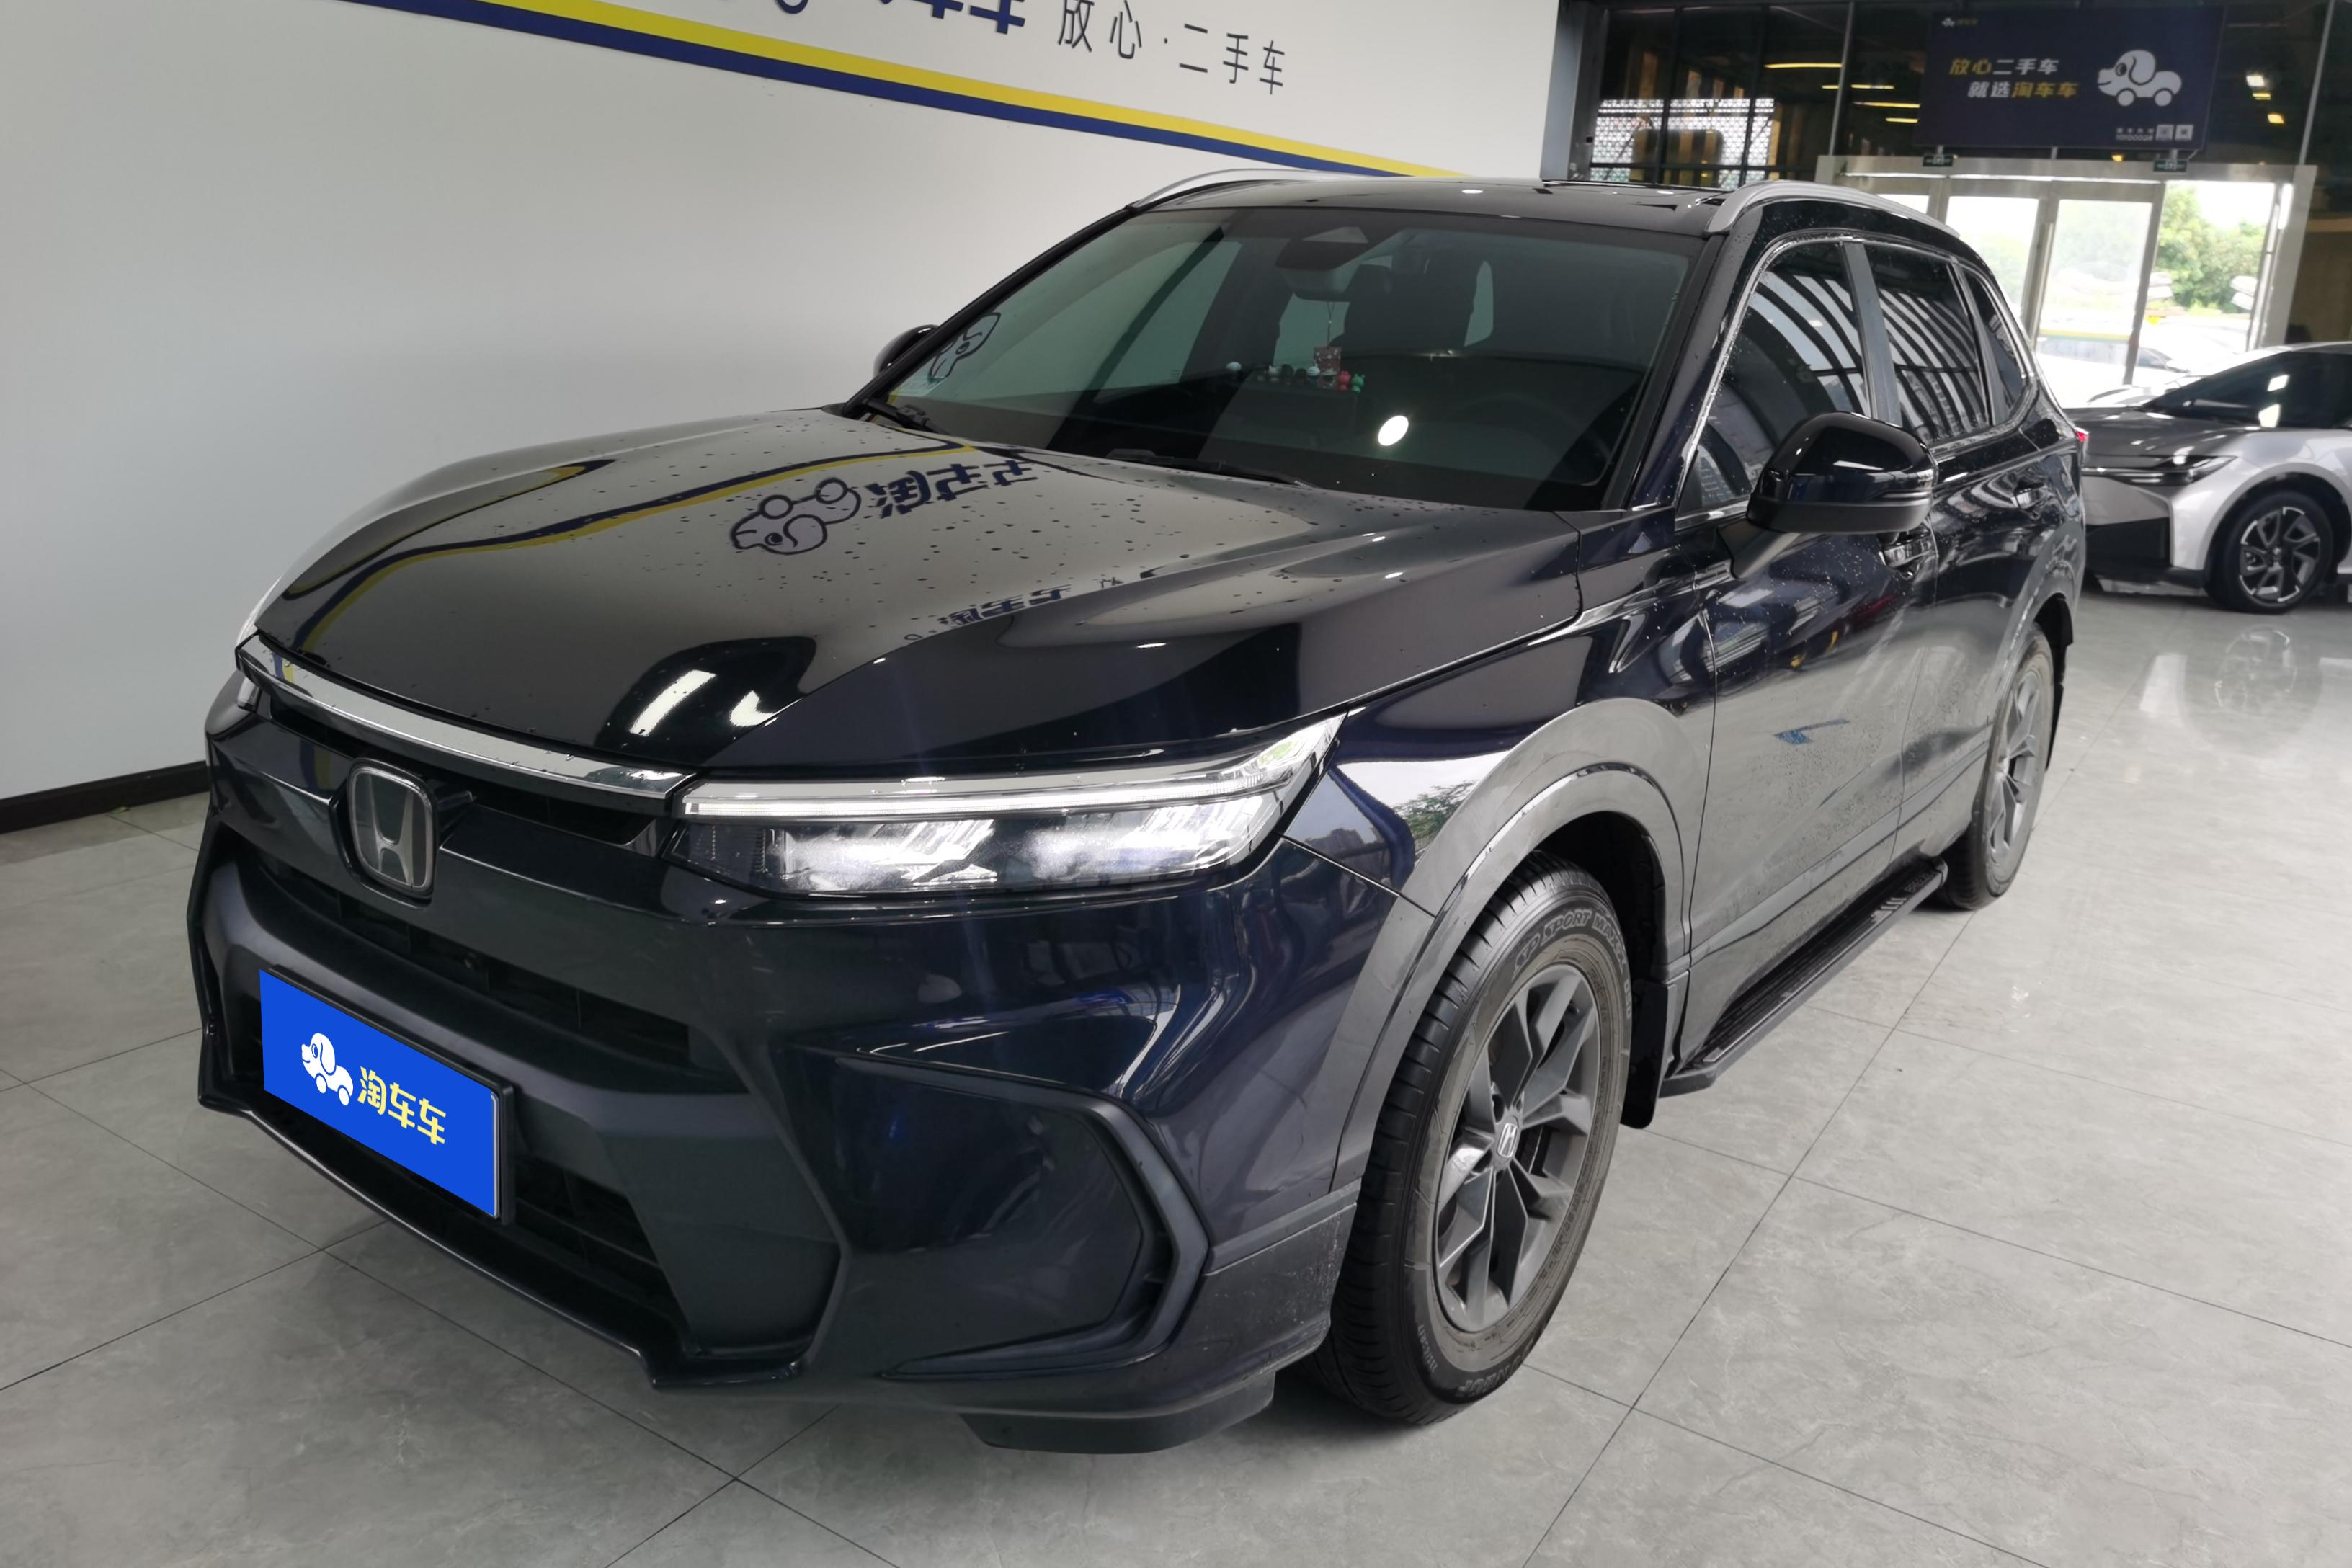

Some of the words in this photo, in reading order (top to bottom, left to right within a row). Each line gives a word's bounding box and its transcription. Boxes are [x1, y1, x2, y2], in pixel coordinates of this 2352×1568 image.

[1949, 58, 2059, 75] 放心二手车
[1967, 81, 2079, 98] 就选淘车车
